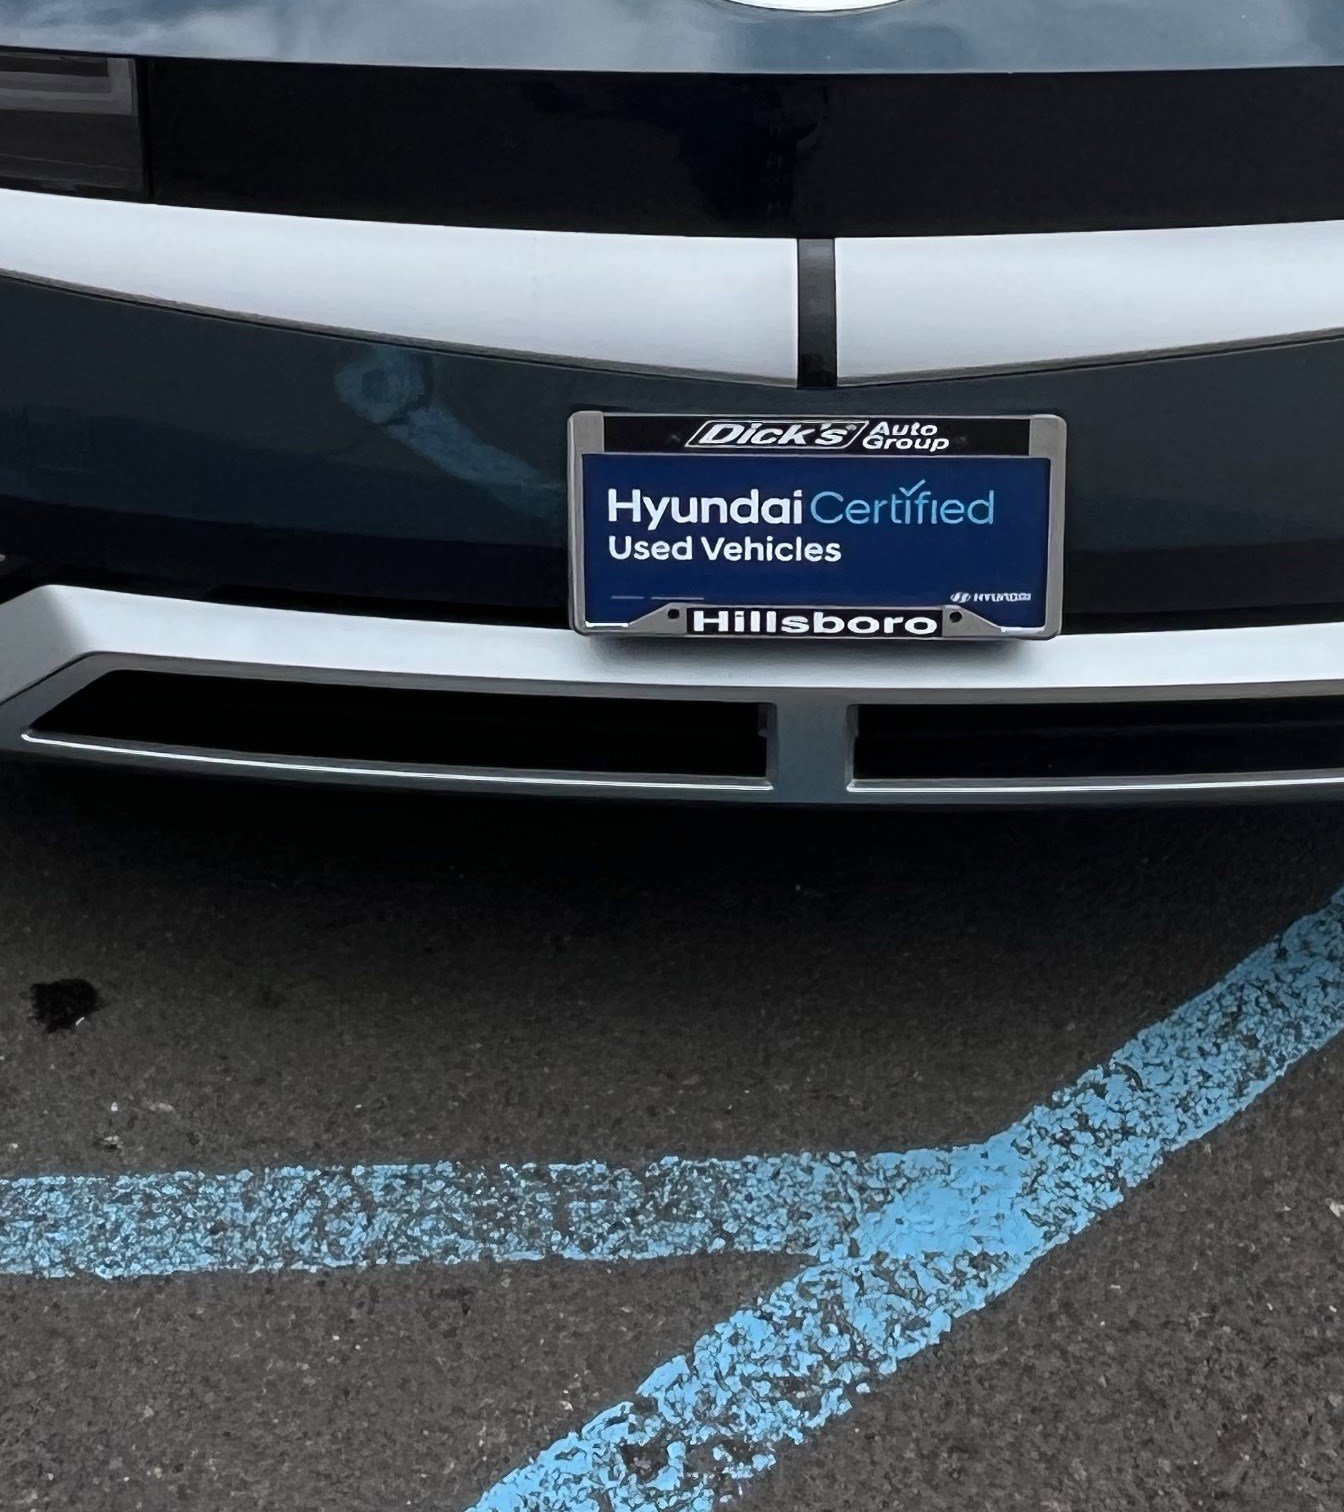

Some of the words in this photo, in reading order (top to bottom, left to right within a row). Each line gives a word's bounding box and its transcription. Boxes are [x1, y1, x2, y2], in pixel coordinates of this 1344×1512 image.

[698, 422, 848, 446] Dick's
[868, 421, 938, 437] Auto
[862, 435, 950, 452] Group
[608, 489, 803, 530] Hyundai
[810, 480, 995, 525] Certified
[608, 536, 693, 560] Used
[701, 536, 842, 562] Vehicles
[692, 610, 937, 635] Hillsboro
